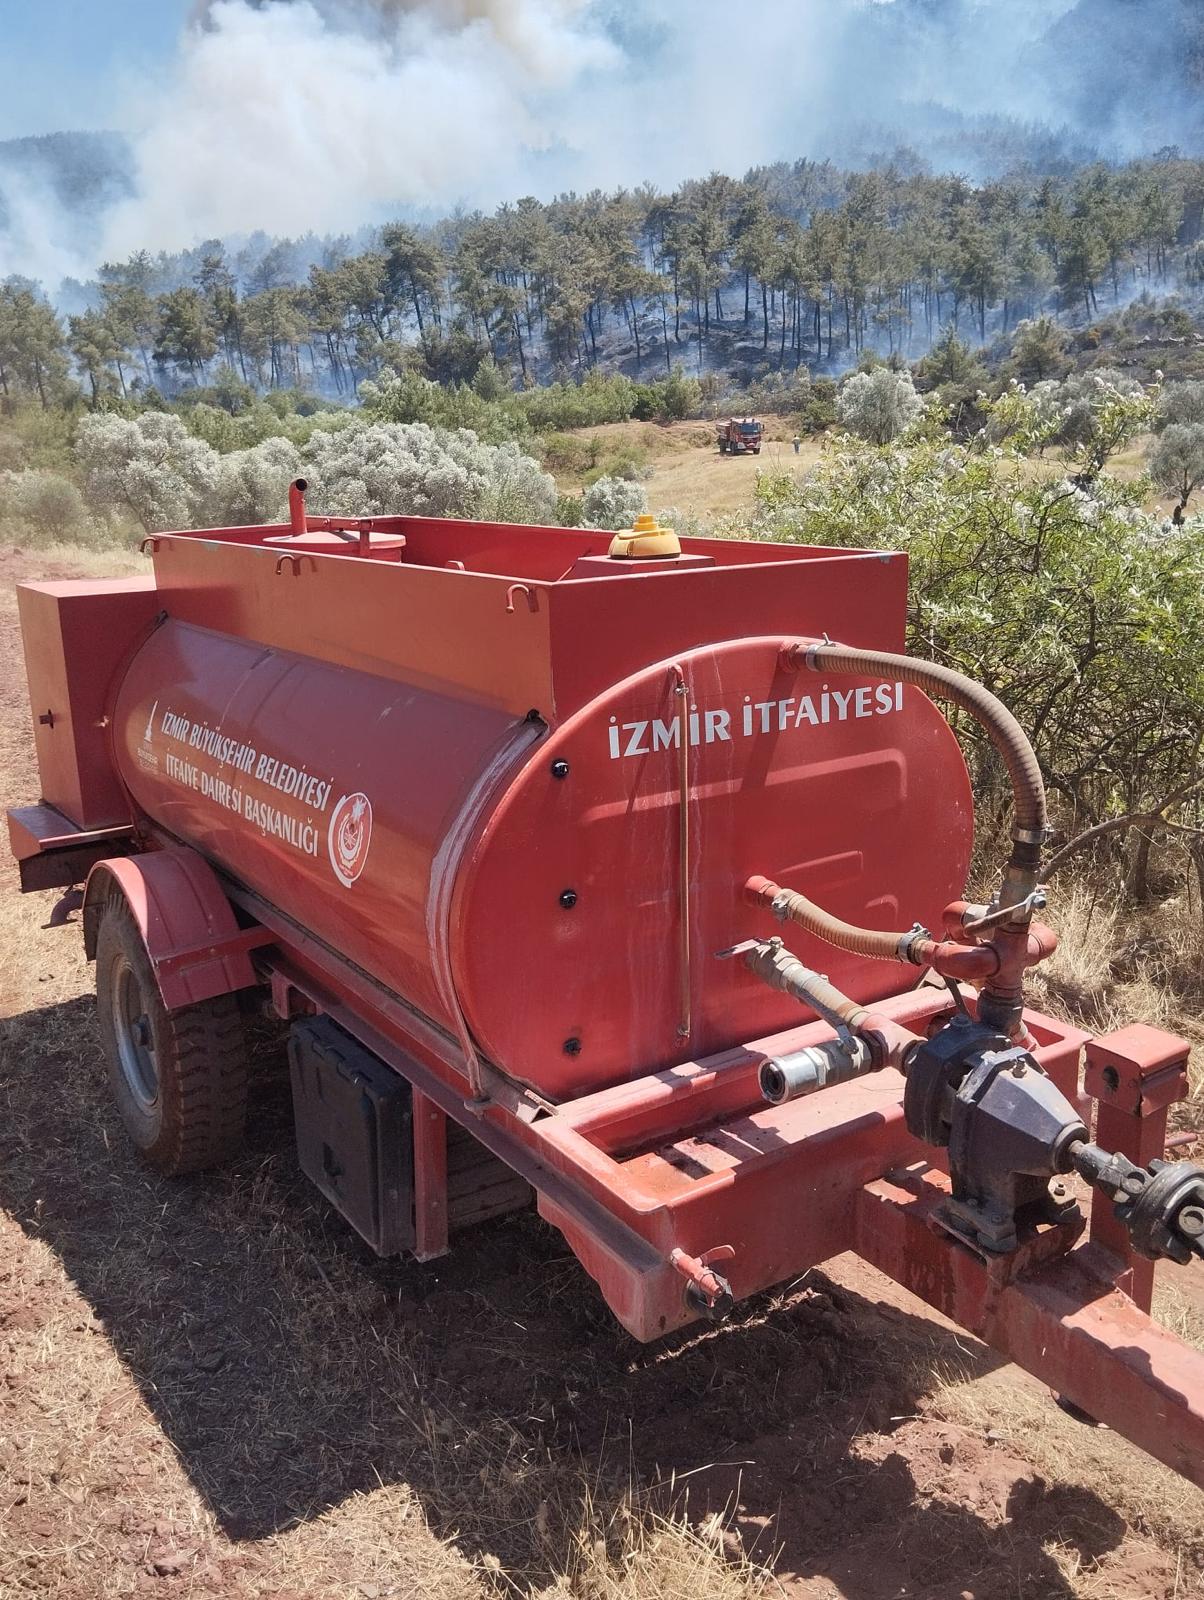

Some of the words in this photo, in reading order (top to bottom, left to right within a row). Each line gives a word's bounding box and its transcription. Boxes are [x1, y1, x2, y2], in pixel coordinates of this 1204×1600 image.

[161, 706, 190, 743] İZMİR
[189, 721, 256, 775] BÜYÜKŞEHİR
[255, 753, 334, 812] BELEDİYESİ
[608, 704, 731, 759] İZMİR
[166, 747, 199, 791] İTFAİYE
[201, 772, 242, 814] DAİRESİ
[245, 795, 319, 857] BAŞKANLIĞI
